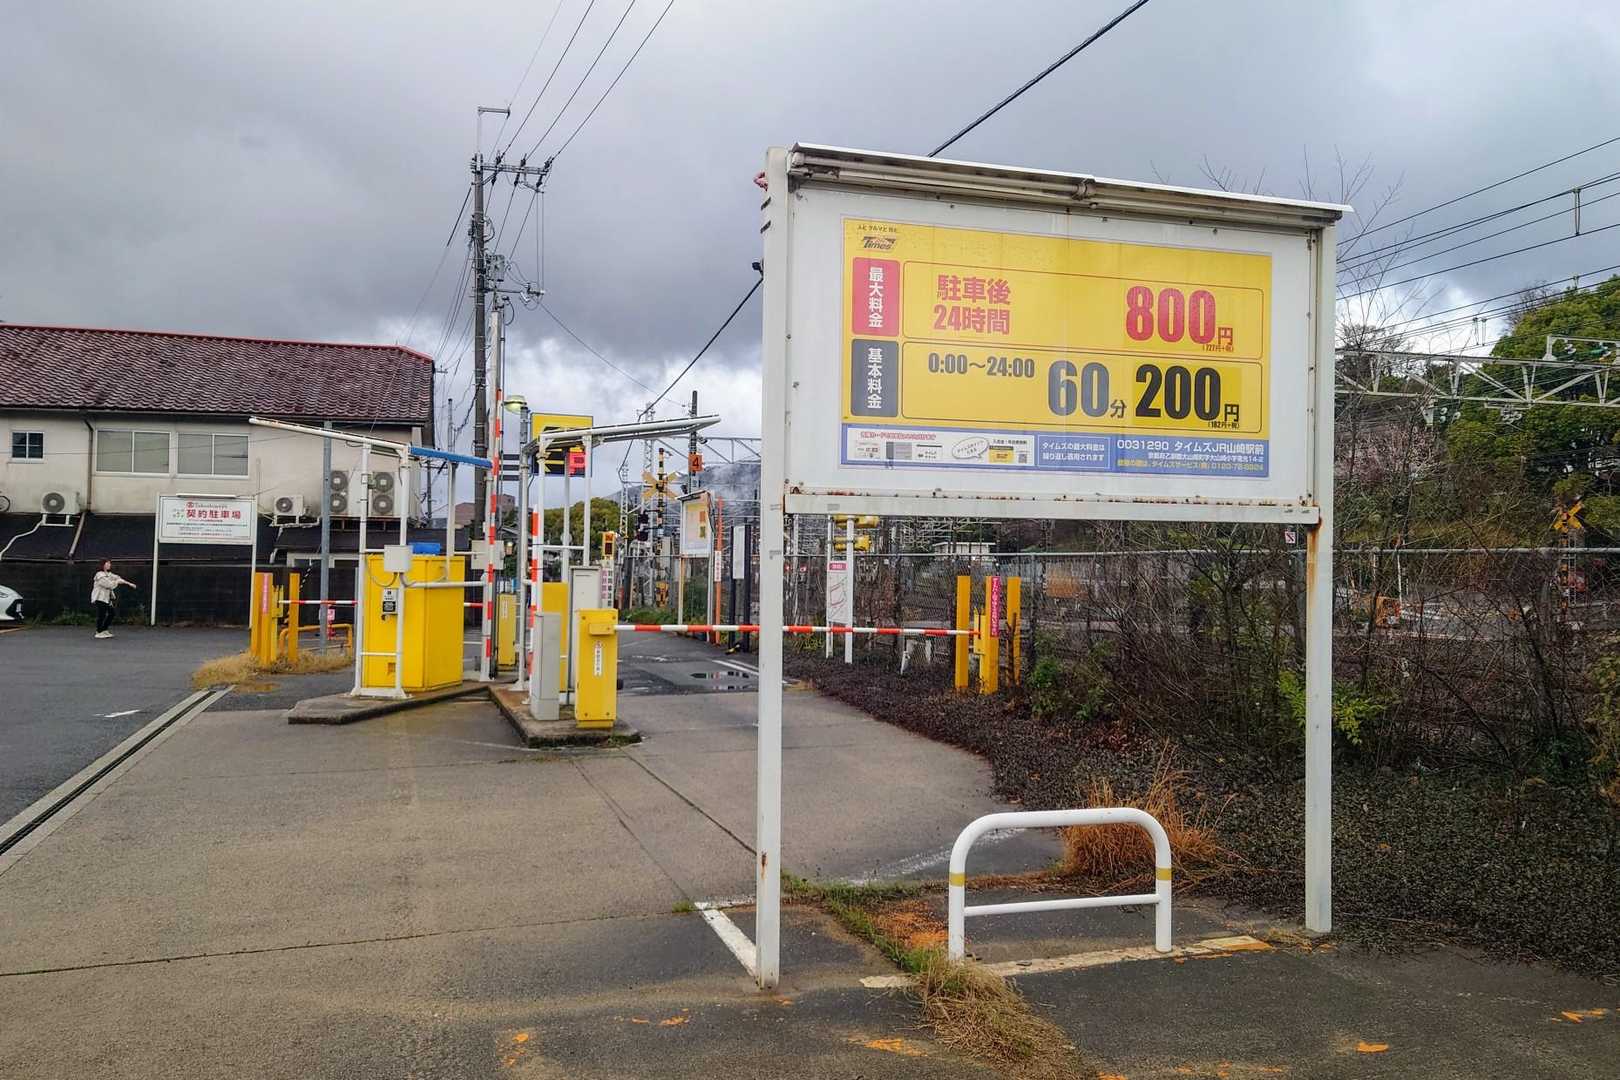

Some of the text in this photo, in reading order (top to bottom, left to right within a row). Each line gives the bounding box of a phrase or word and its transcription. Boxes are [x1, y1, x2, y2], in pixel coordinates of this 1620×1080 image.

[868, 266, 883, 328] 最大料金
[933, 304, 1010, 335] 24時間
[937, 274, 1011, 306] 駐車後
[1126, 285, 1233, 345] 800円
[867, 347, 883, 409] 基本料金
[1047, 360, 1127, 418] 60分
[1135, 363, 1239, 422] 200円
[1117, 439, 1169, 450] 0031290
